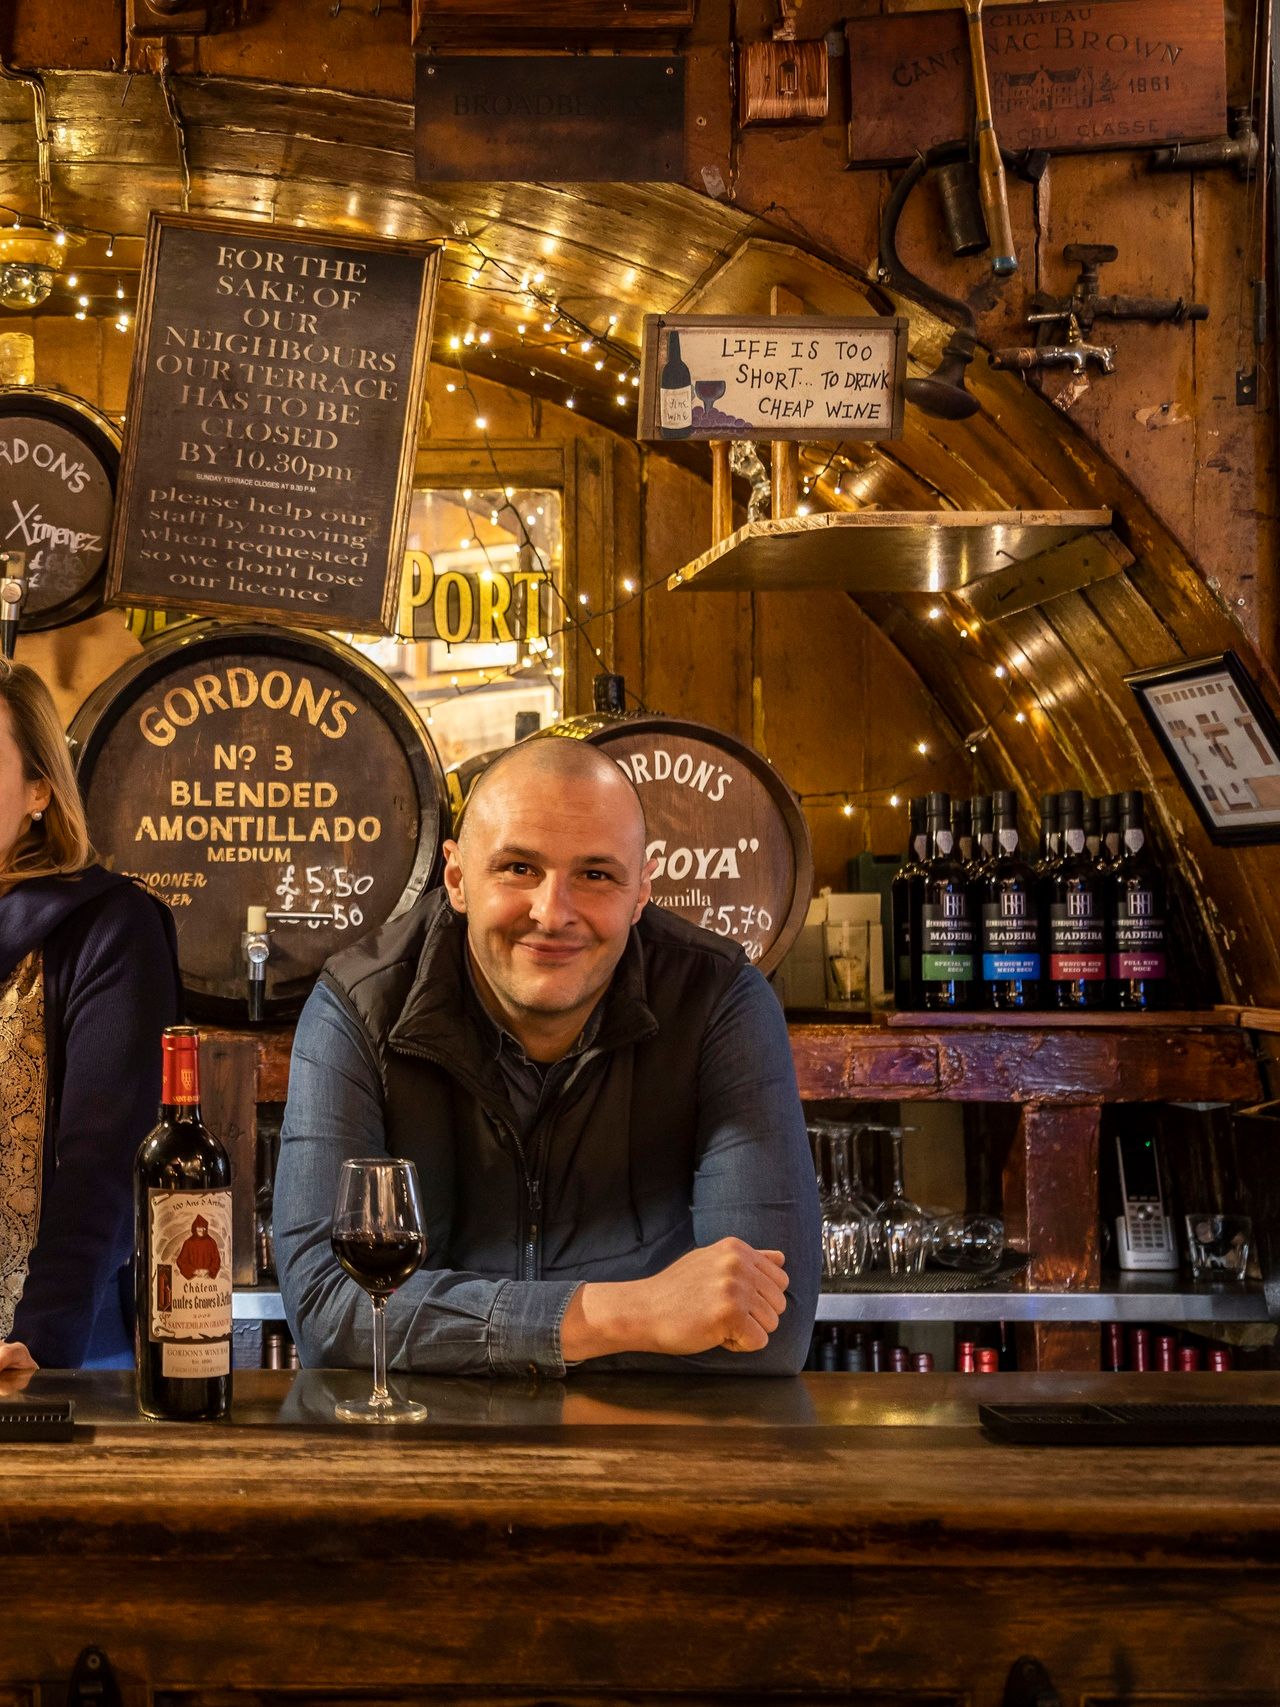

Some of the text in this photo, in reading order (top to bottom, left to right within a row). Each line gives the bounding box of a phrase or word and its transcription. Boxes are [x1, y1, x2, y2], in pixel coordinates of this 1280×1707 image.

[891, 27, 1184, 88] CANTNAC BROWN
[216, 246, 368, 284] FOR THE
[216, 275, 361, 310] SAKE OF
[243, 307, 319, 335] OUR
[164, 326, 397, 373] NEIGHBOURS
[721, 337, 873, 362] LIFE IS TOO
[155, 353, 399, 401] OUR TERRACE
[820, 370, 840, 391] TO
[844, 369, 891, 392] DRINK
[180, 384, 361, 426] HAS TO BE
[758, 396, 882, 420] CHEAP WINE
[200, 416, 340, 451] CLOSED
[178, 441, 353, 482] BY 10.30pm
[195, 473, 223, 483] SUNDAY
[223, 475, 254, 487] TERRACE
[253, 479, 280, 490] CLOSES
[280, 482, 290, 490] AT
[148, 486, 373, 528] please help our
[4, 499, 104, 555] Ximenez
[148, 508, 369, 550] staff by moving
[139, 526, 369, 569] when requested
[139, 549, 365, 588] so we don't lose
[169, 572, 330, 603] our licence
[398, 550, 555, 646] PORT
[138, 666, 359, 747] GORDON'S
[274, 745, 294, 772] 3
[170, 780, 339, 808] BLENDED
[134, 815, 382, 843] AMONTILLADO
[207, 847, 292, 863] MEDIUM
[275, 864, 374, 898] £5.50
[989, 931, 1037, 941] MADEIRA
[1055, 931, 1102, 941] MADEIRA
[1115, 930, 1164, 940] MADEIRA
